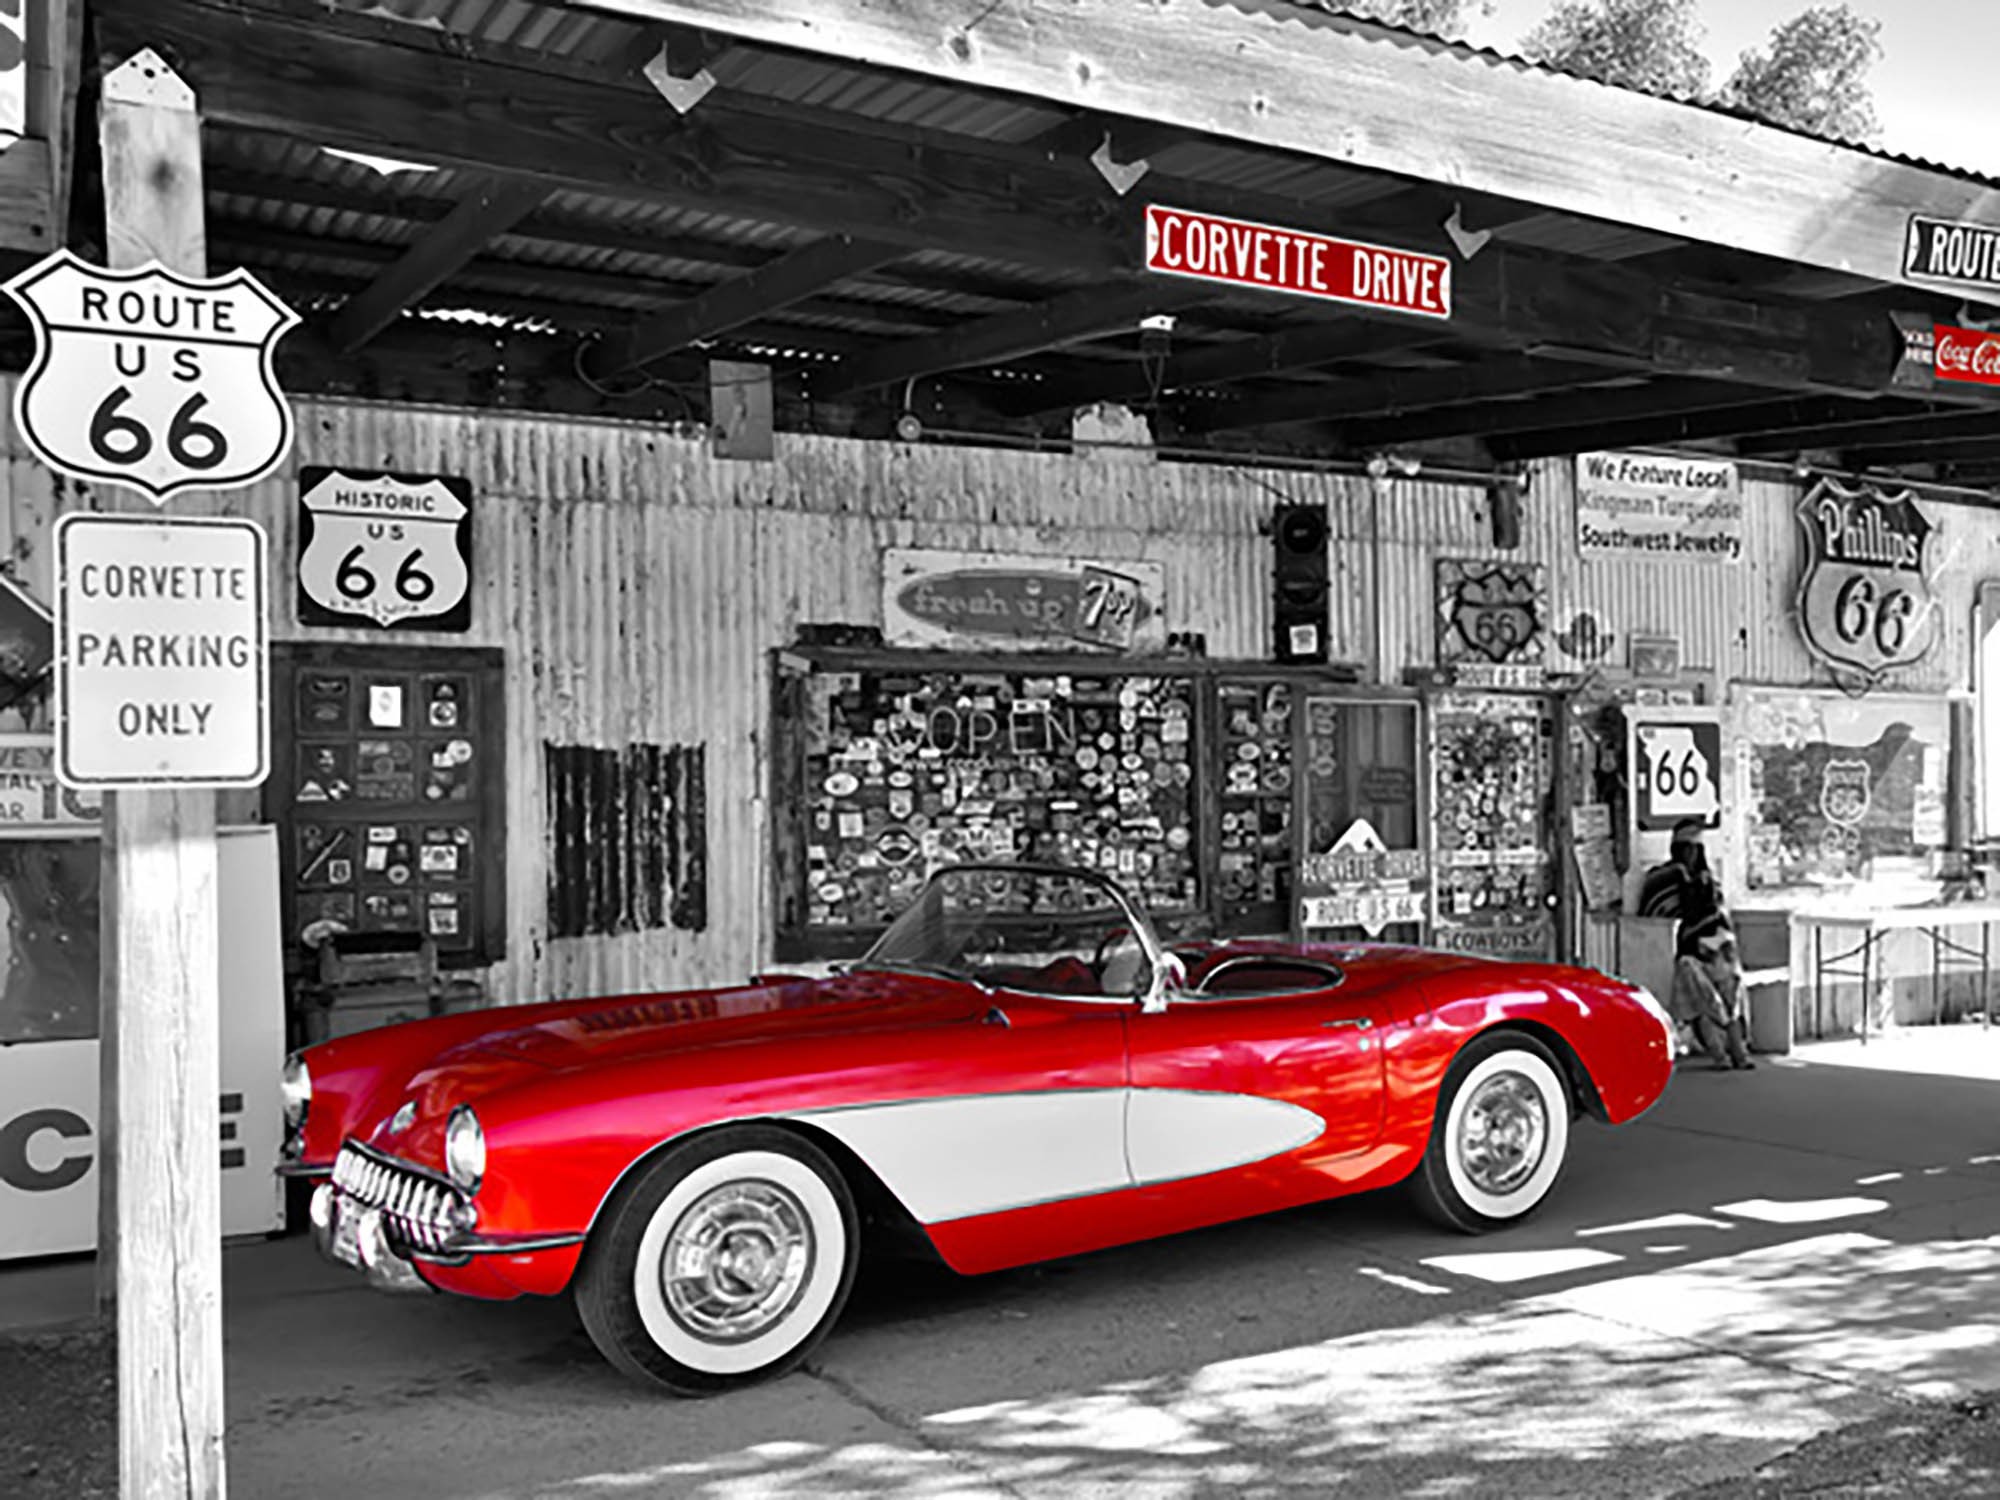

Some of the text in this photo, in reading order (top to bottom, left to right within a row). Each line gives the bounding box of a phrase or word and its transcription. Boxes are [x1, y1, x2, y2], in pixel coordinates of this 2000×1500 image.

[1163, 216, 1438, 309] CORVETTE DRIVE
[81, 286, 236, 333] ROUTE
[89, 385, 228, 470] 66
[1586, 457, 1727, 489] We Feature Local
[335, 490, 435, 512] HISTORIC
[1578, 489, 1742, 524] Kingman Turquoise
[1581, 524, 1741, 559] Southwest Jewelry
[1818, 499, 1918, 574] Phillips
[80, 564, 246, 601] CORVETTE
[336, 544, 435, 603] 66
[1476, 611, 1518, 645] 66
[1834, 574, 1914, 659] 66
[77, 634, 250, 669] PARKING
[118, 703, 214, 737] ONLY
[929, 705, 1077, 755] OPEN
[1655, 749, 1700, 796] 66
